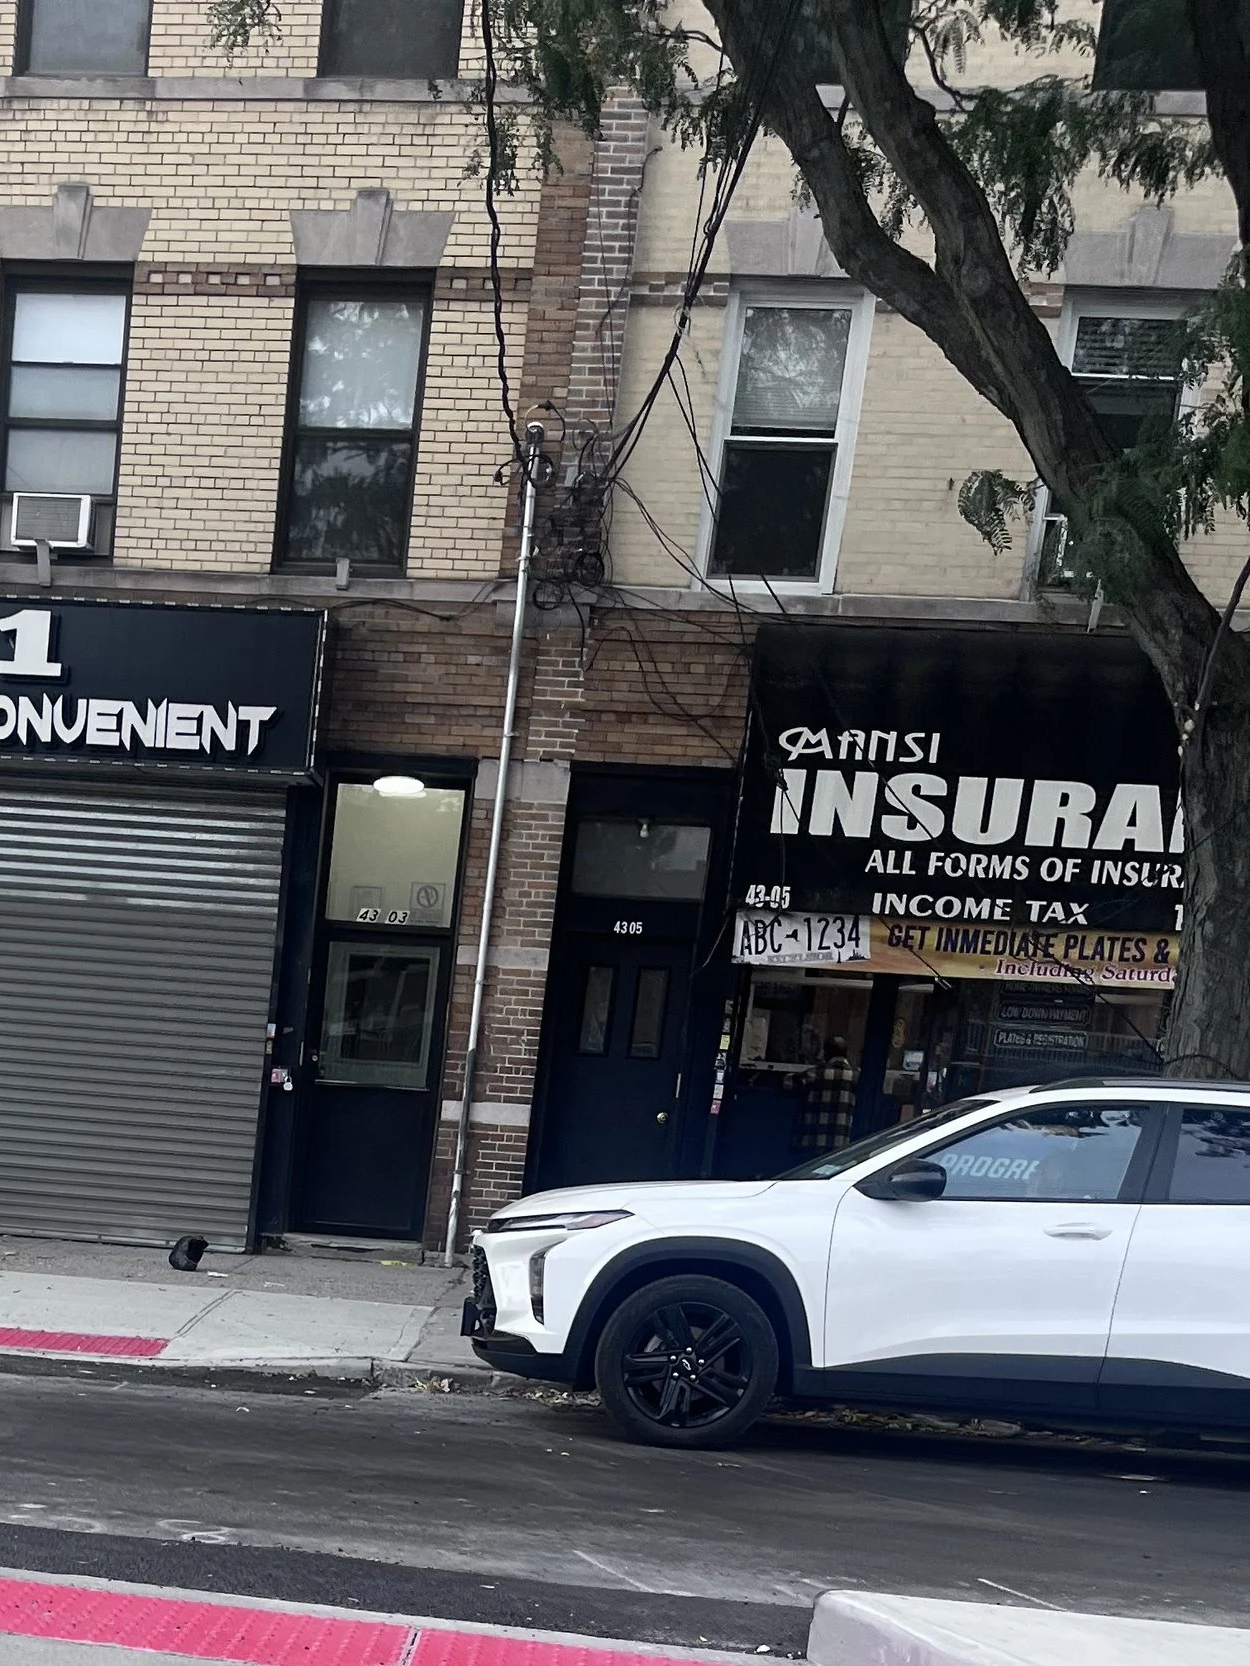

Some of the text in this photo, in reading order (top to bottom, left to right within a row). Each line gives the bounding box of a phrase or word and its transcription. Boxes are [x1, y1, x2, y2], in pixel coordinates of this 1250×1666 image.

[864, 849, 1185, 889] ALL FORMS OF INSUR
[745, 884, 792, 910] 43-05
[871, 892, 1014, 921] INCOME
[1026, 900, 1090, 925] TAX
[358, 909, 379, 922] 43
[388, 911, 408, 924] 03
[613, 920, 643, 935] 4305
[741, 914, 861, 956] ABC 1234
[887, 924, 1170, 964] GET INMEDIATE PLATES &
[996, 959, 1095, 983] Including
[998, 1032, 1026, 1045] PLATES
[1033, 1033, 1085, 1047] REGISTRATION
